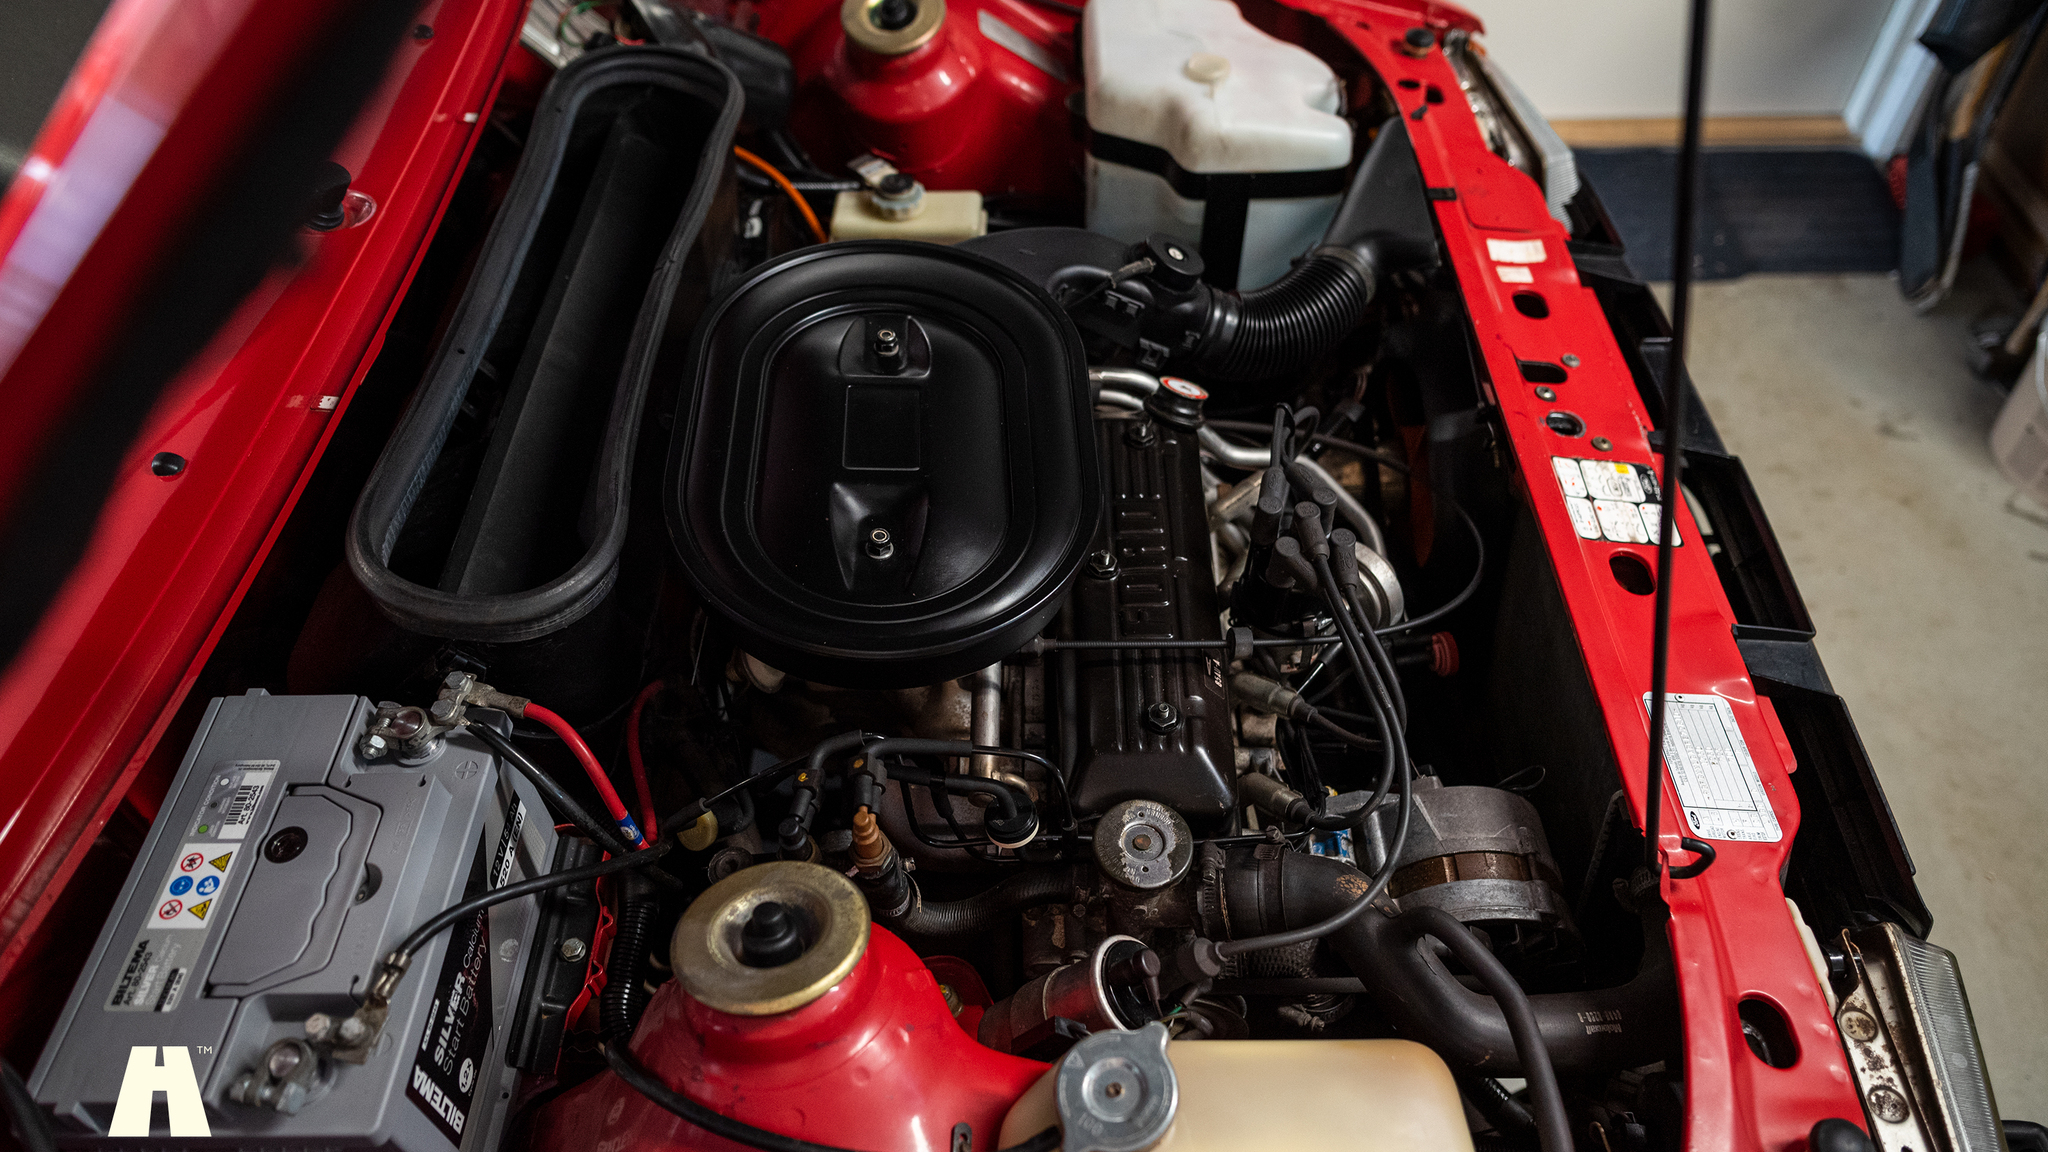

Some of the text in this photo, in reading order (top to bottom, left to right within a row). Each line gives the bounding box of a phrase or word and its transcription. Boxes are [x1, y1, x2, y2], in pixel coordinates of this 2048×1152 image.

[243, 785, 260, 812] 80-2543
[492, 860, 502, 877] 12
[498, 846, 504, 858] V
[500, 811, 523, 888] 520 A (EN)
[111, 939, 151, 1006] BILTEMA
[131, 951, 153, 987] 80-2543
[133, 965, 160, 1006] SILVER
[434, 908, 485, 1067] SILVER Calcium
[442, 936, 487, 1076] Start Battery
[412, 1064, 465, 1135] BILTEMA
